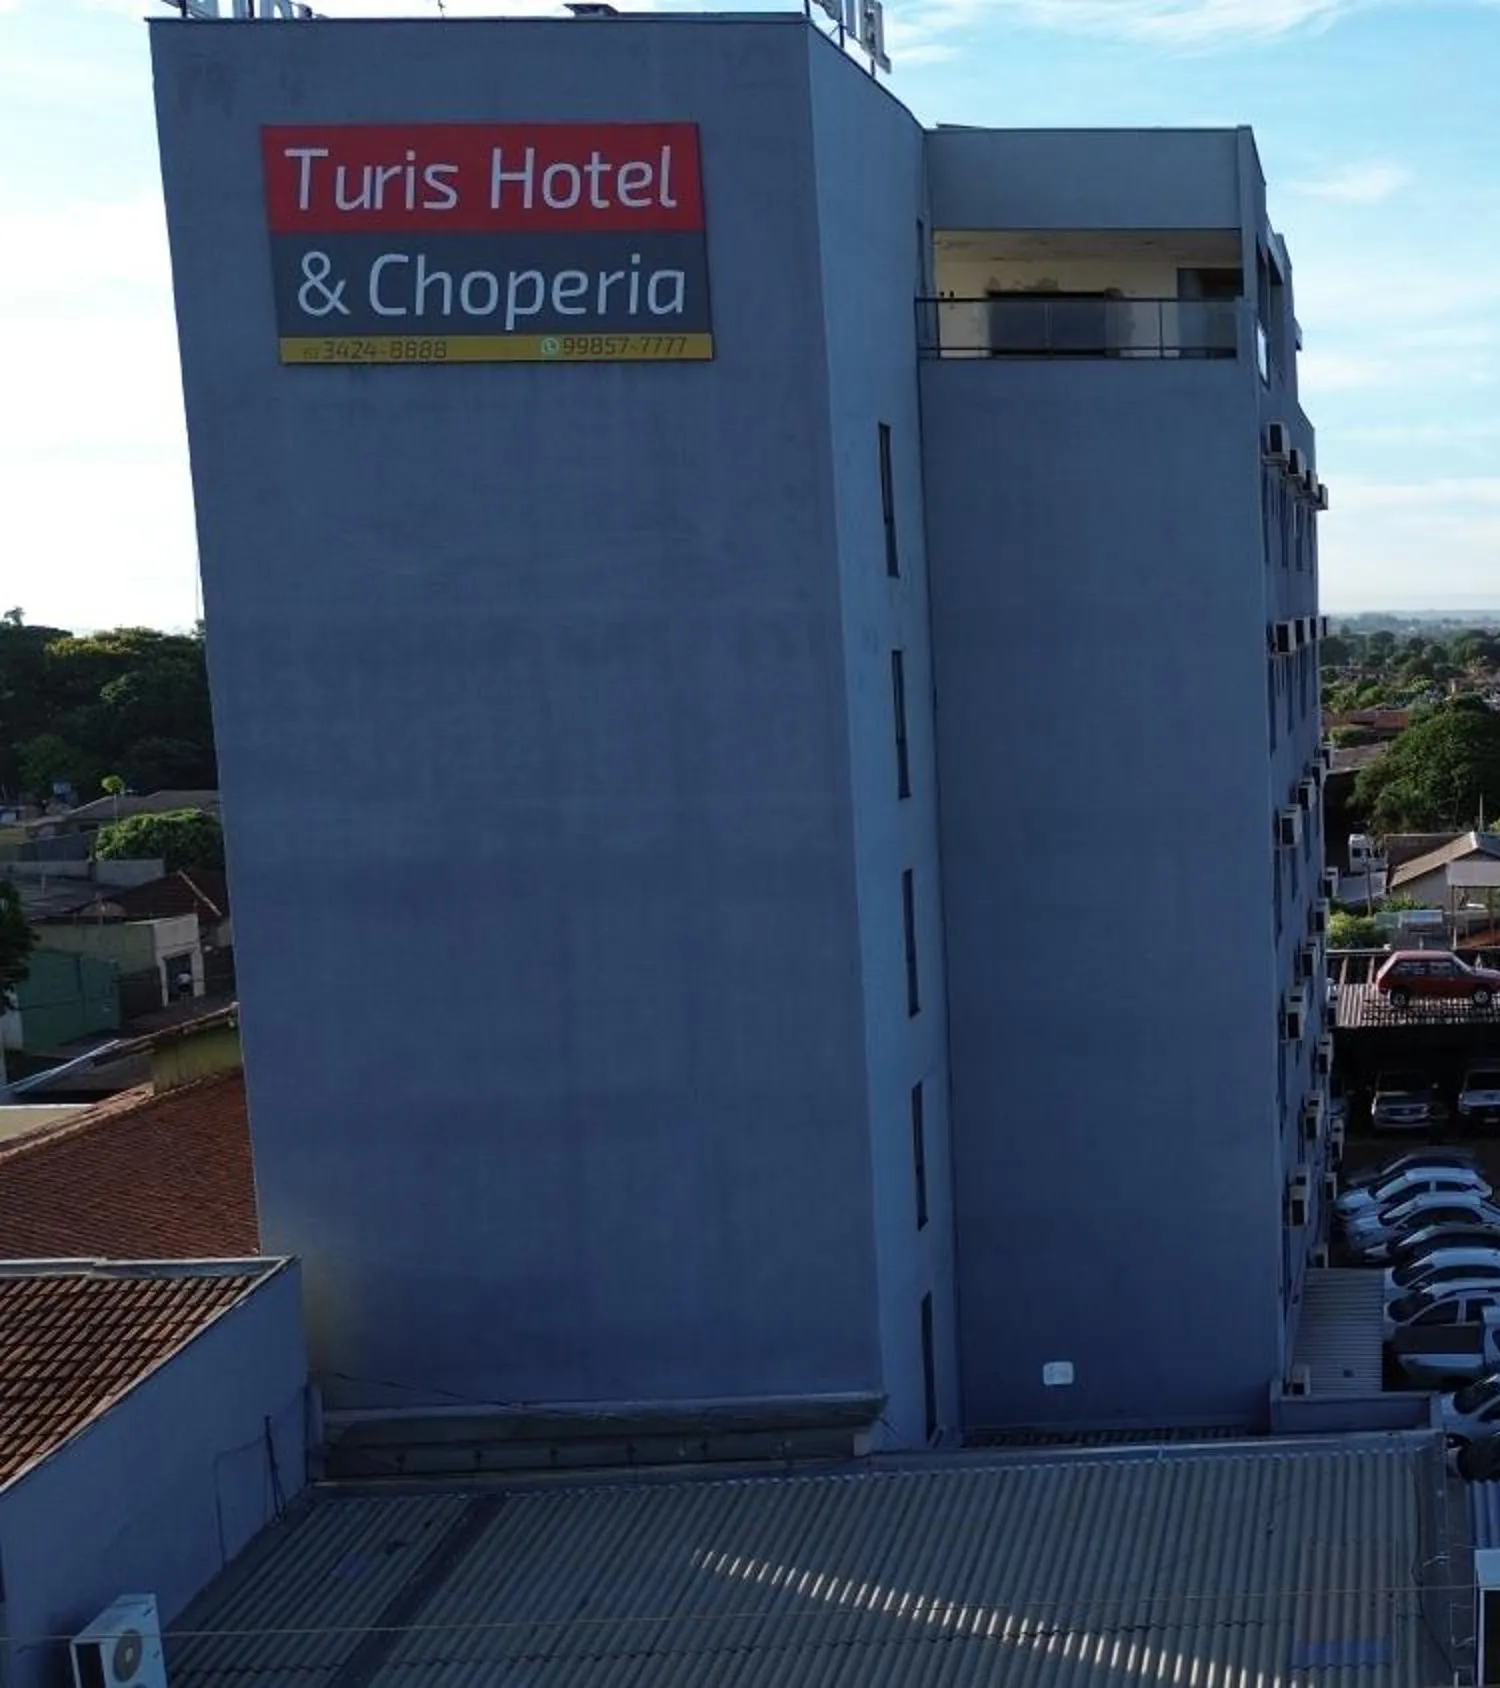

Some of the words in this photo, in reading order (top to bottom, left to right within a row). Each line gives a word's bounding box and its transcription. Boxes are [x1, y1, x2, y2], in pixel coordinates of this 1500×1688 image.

[284, 148, 459, 211] Turis
[490, 145, 679, 210] Hotel
[297, 251, 351, 317] &
[368, 252, 686, 331] Choperia
[323, 341, 448, 360] 3424-8888
[563, 336, 687, 355] 99857-7777
